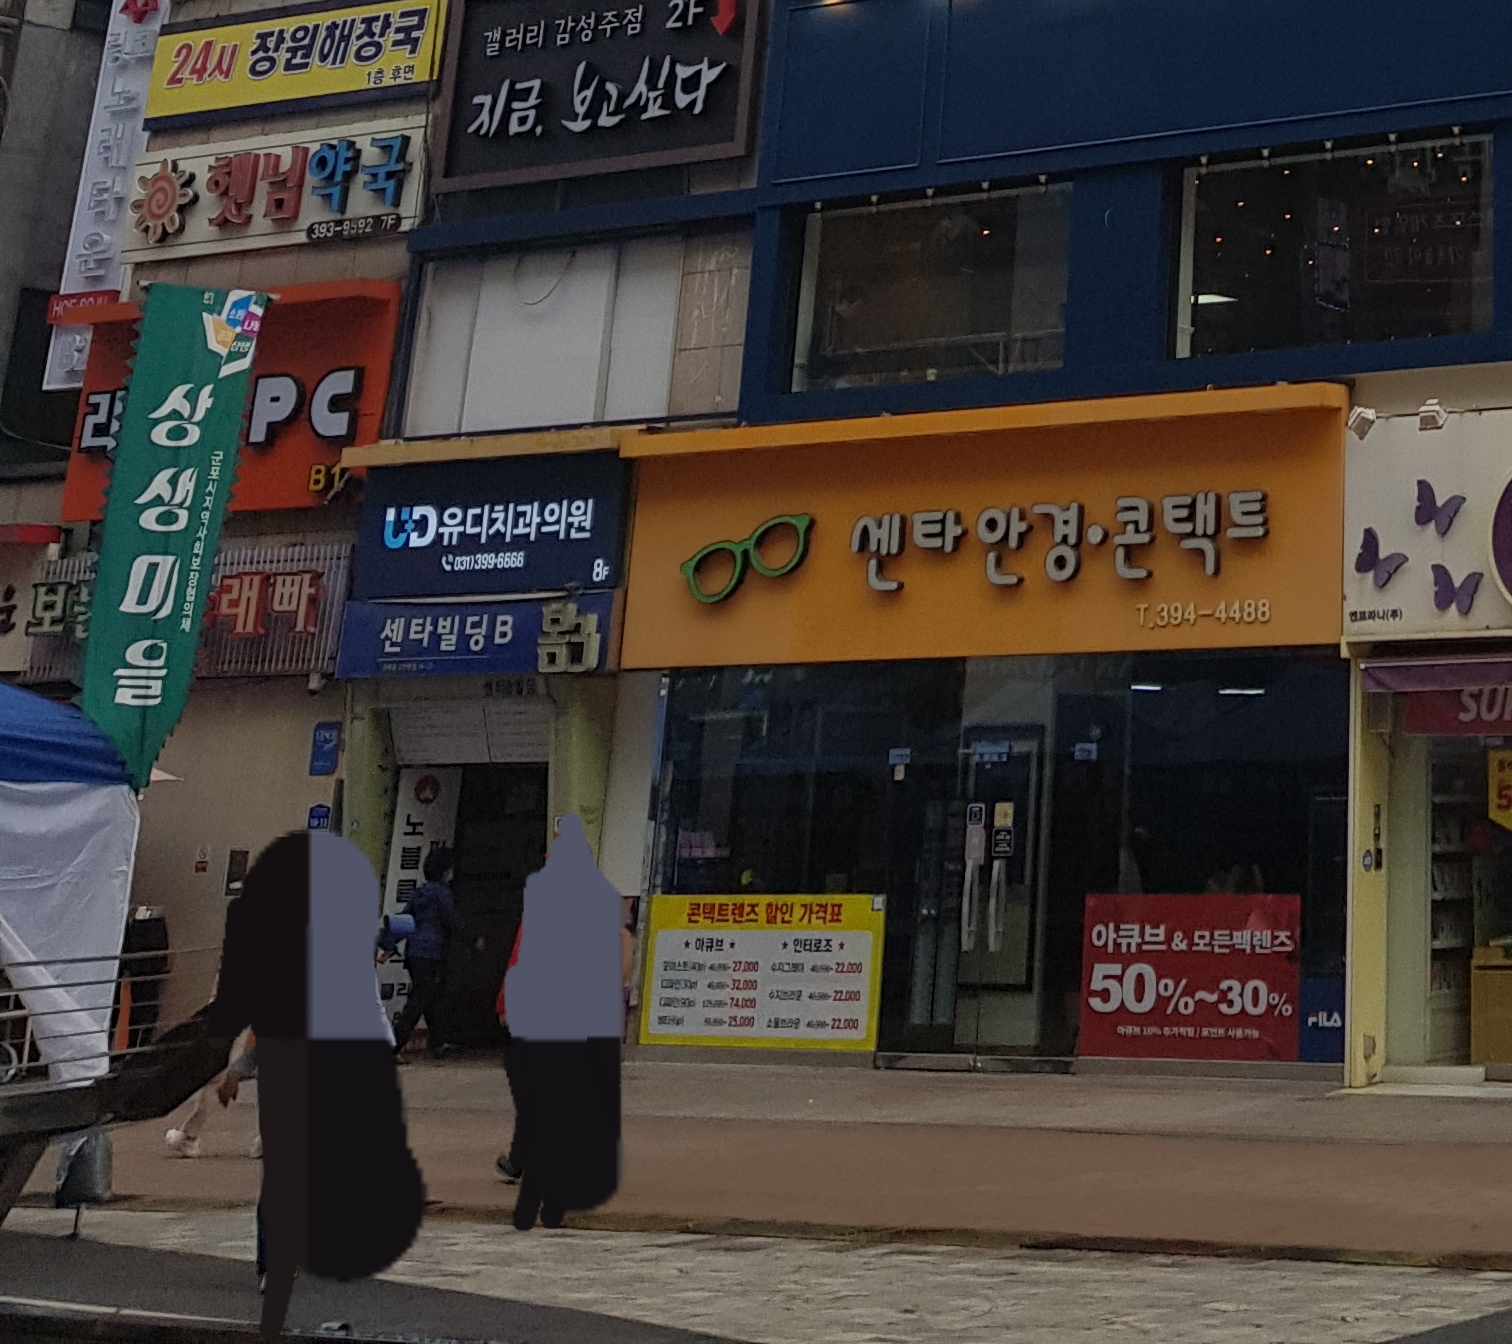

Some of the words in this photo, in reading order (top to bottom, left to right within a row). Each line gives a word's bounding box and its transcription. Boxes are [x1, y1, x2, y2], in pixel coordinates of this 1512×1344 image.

[482, 19, 547, 58] 갤러리
[553, 4, 645, 49] 감성주점
[163, 38, 237, 89] 24시
[246, 5, 430, 81] 장원해장국
[365, 67, 387, 87] 1층
[387, 62, 417, 84] 후면
[379, 213, 398, 234] 7F
[437, 497, 595, 547] 유디치과의원
[453, 551, 525, 571] 031)399-6666
[592, 558, 609, 582] 8F
[379, 613, 489, 653] 센타빌딩
[765, 902, 795, 925] 할인
[798, 902, 844, 925] 가격표
[694, 937, 725, 953] 아큐브
[792, 938, 834, 954] 인터로조
[1090, 921, 1168, 954] 아큐브
[1170, 930, 1189, 952] &
[1191, 928, 1295, 955] 모든팩렌즈
[1307, 1010, 1342, 1028] FILA
